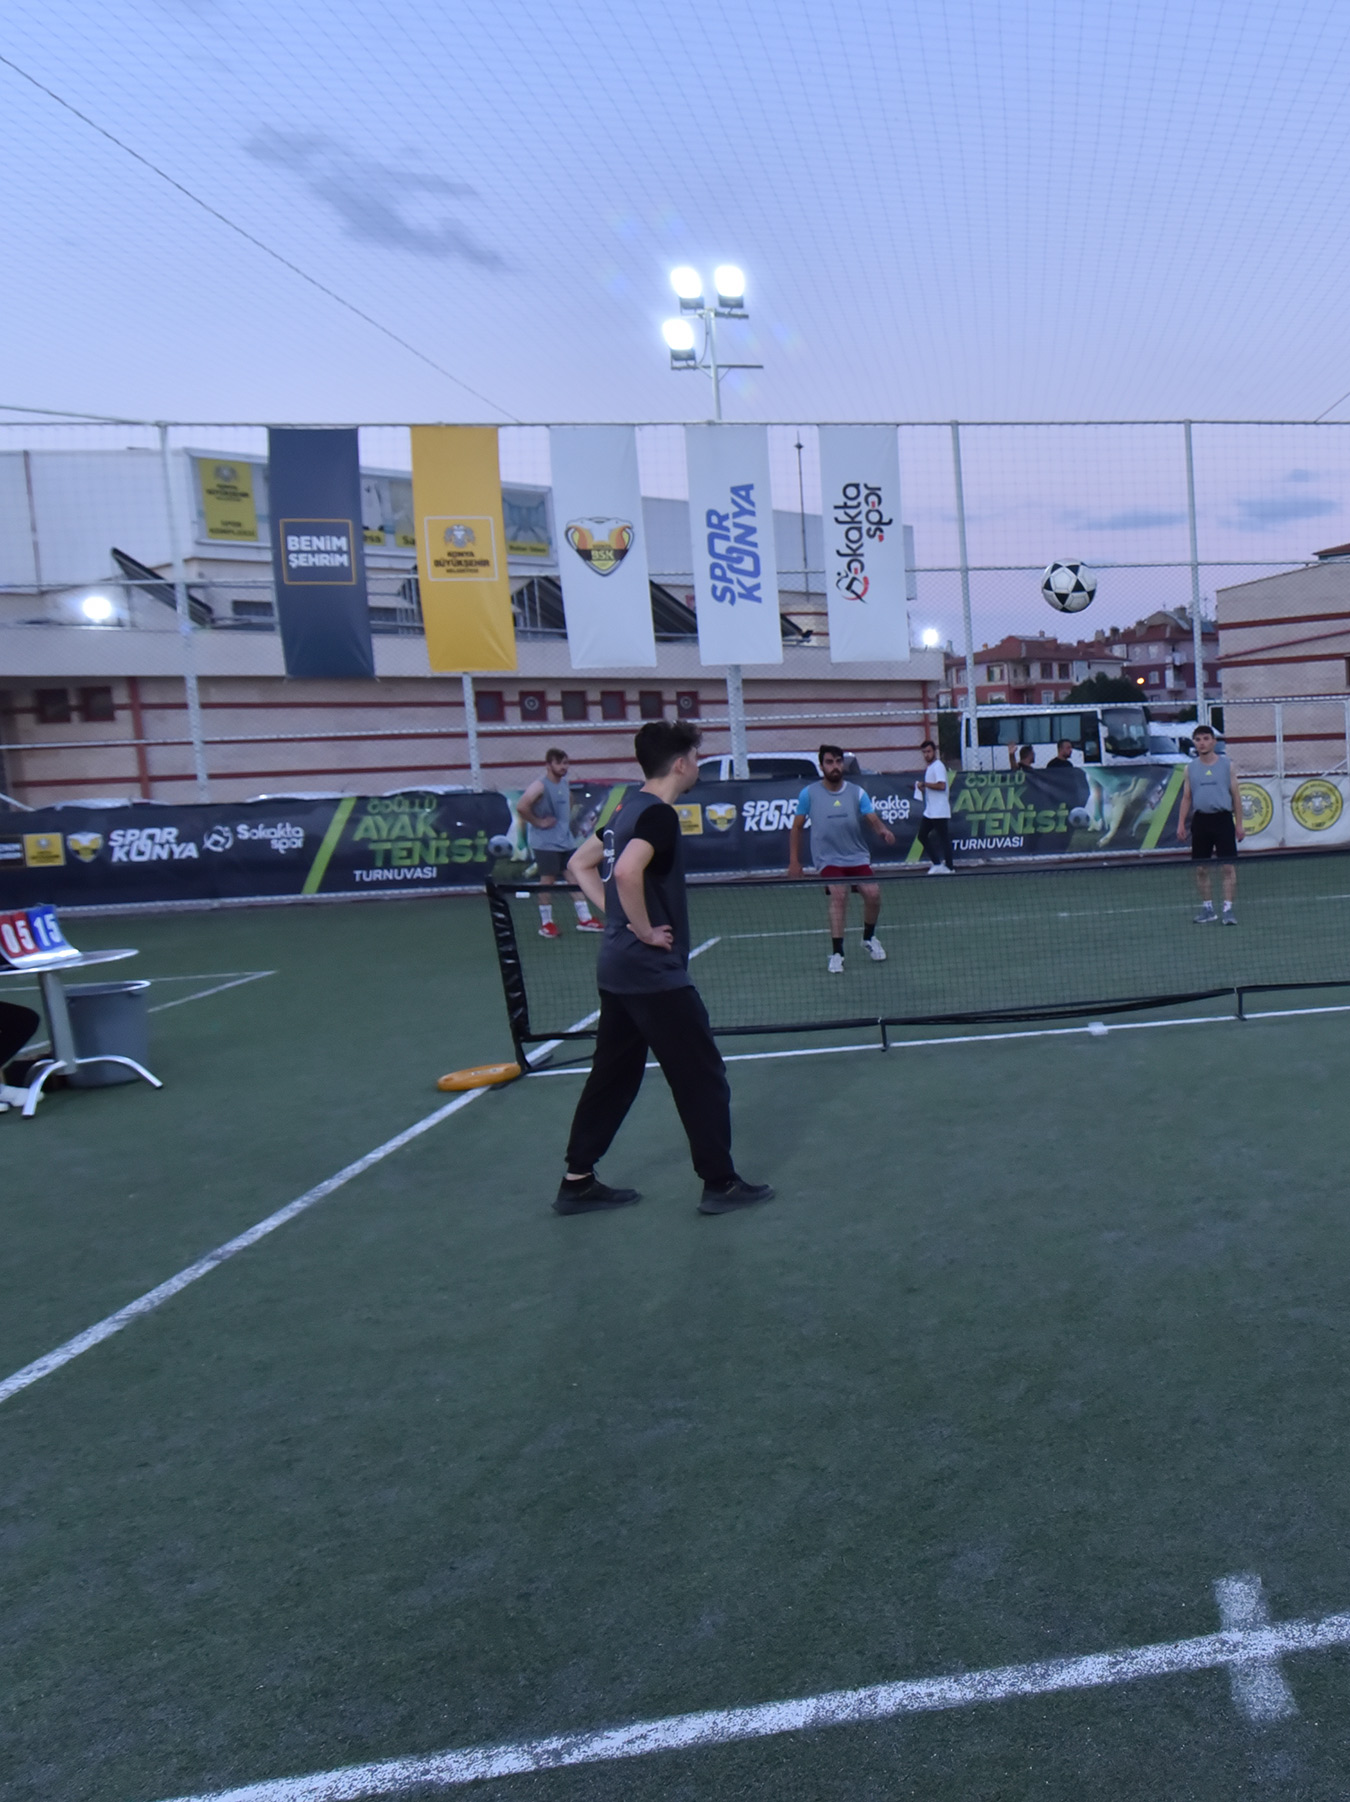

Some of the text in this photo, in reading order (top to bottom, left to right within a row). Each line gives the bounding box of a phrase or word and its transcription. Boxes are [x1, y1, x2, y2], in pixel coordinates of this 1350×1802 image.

[863, 483, 893, 543] spor
[287, 535, 348, 551] BENİM
[727, 483, 762, 603] KONYA
[288, 552, 349, 568] ŞEHRİM
[706, 508, 741, 606] SPOR
[742, 799, 799, 817] SPOR
[953, 786, 1028, 813] AYAK
[882, 807, 911, 824] spor
[965, 803, 1069, 837] TENİSİ
[236, 821, 304, 841] Sokakta
[353, 812, 439, 841] AYAK
[108, 827, 179, 848] SPOR
[270, 836, 304, 854] spor
[952, 836, 1024, 850] TURNUVASI
[111, 842, 199, 862] KONYA
[368, 831, 489, 867] TENİSİ
[353, 867, 437, 882] TURNUVASI
[33, 913, 62, 946] 15
